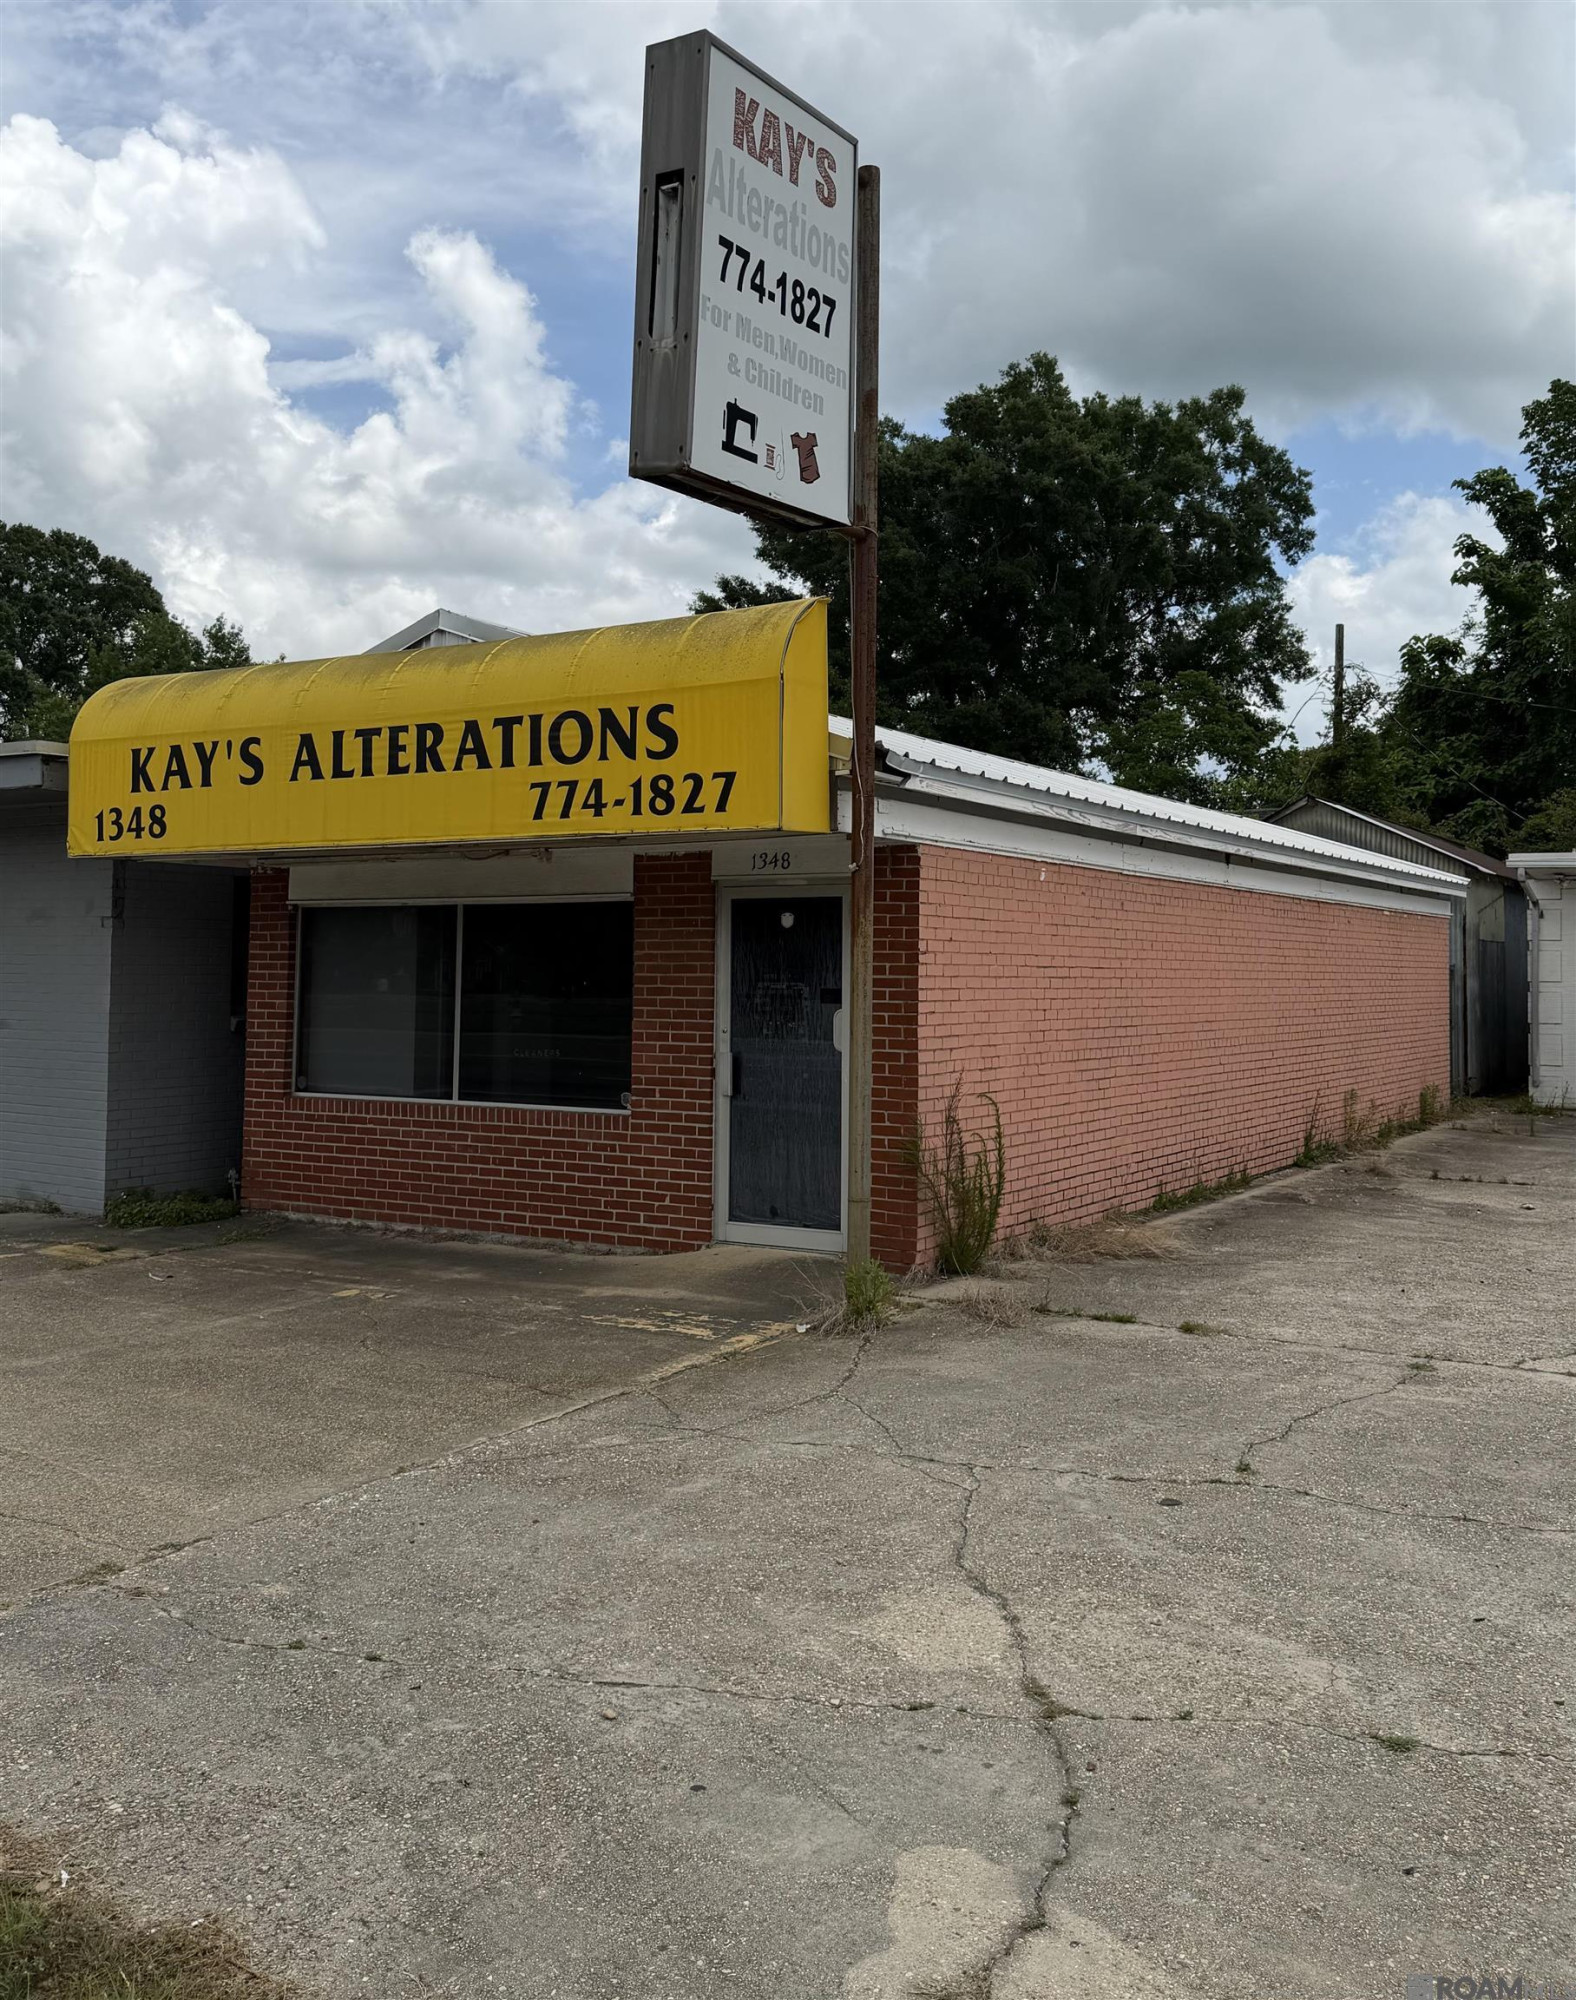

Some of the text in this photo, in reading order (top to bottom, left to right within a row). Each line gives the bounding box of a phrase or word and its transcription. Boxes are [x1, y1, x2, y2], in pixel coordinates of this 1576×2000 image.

[733, 87, 837, 208] KAY'S
[706, 148, 850, 285] Alterations
[700, 294, 732, 333] For
[718, 234, 837, 339] 774-1827
[727, 352, 824, 416] & Children
[130, 703, 679, 794] KAY'S ALTERATIONS
[94, 804, 167, 842] 1348
[529, 771, 738, 821] 774-1827
[751, 852, 791, 871] 1348
